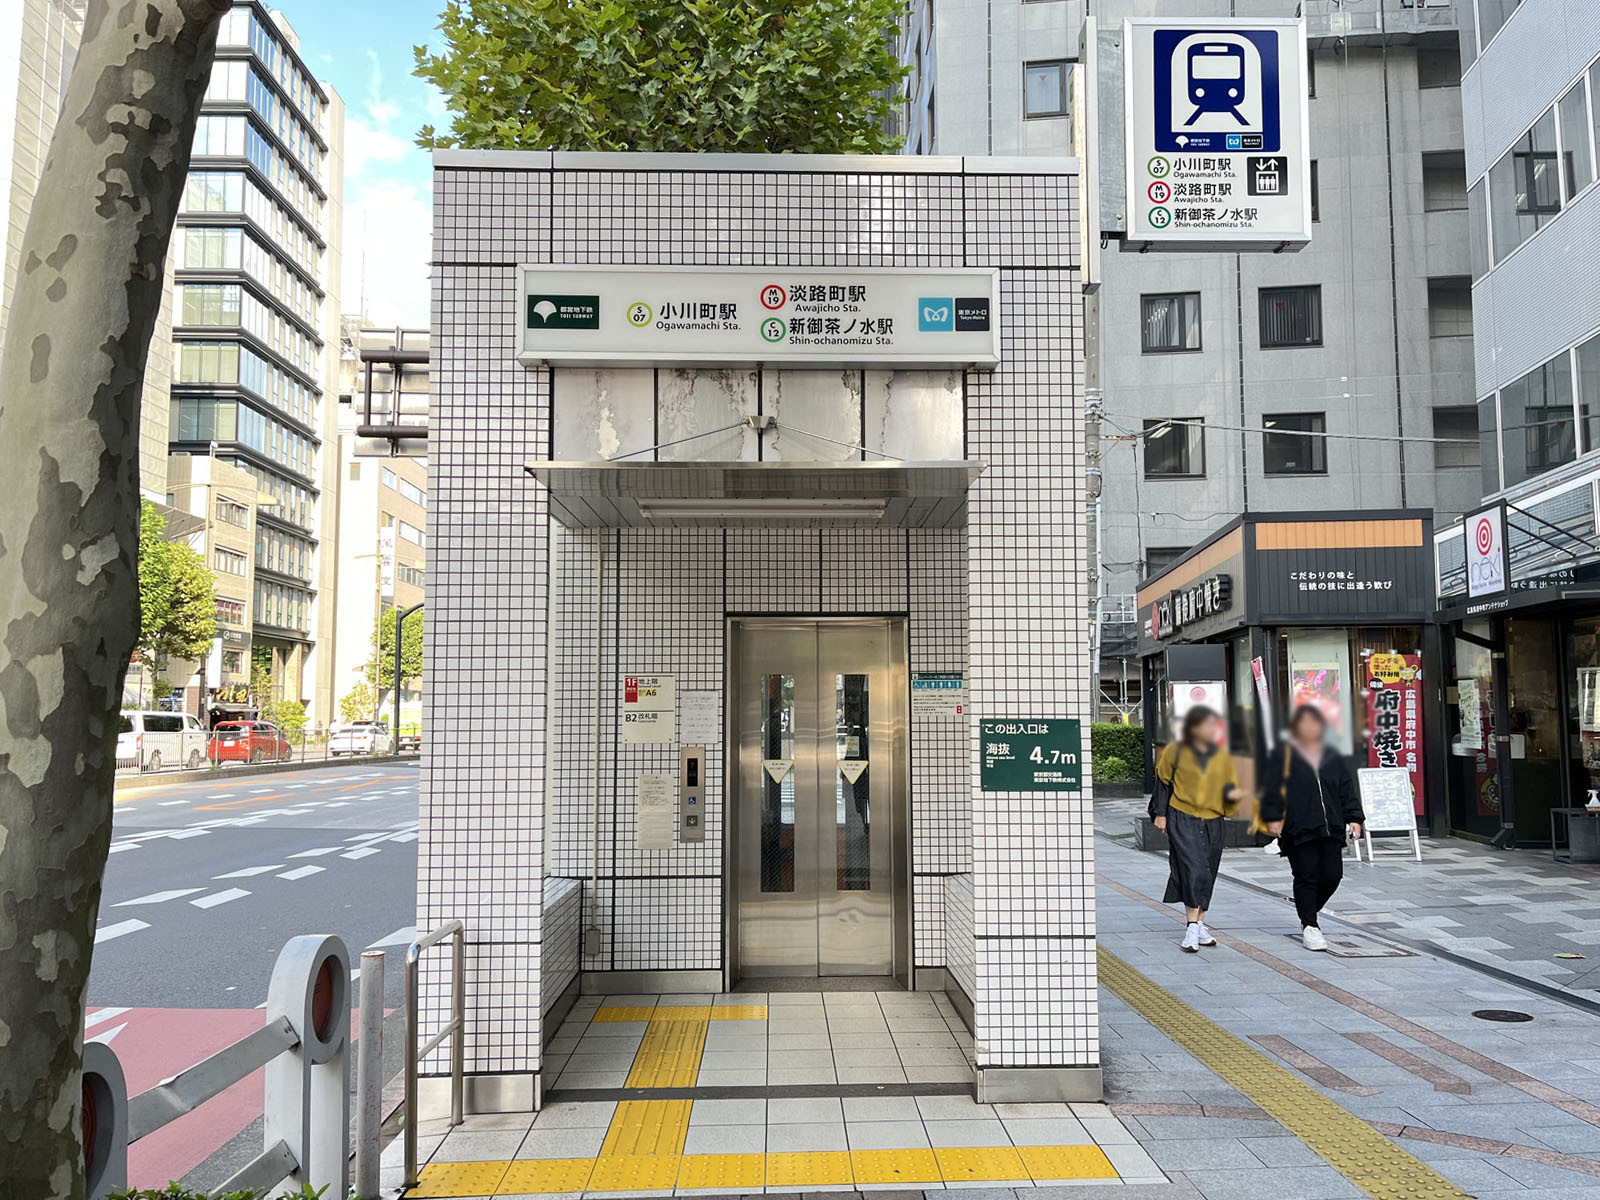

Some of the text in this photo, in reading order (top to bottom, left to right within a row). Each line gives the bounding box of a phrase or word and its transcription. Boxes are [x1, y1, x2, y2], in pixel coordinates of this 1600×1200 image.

[1173, 157, 1231, 171] 小川町駅
[1173, 183, 1232, 196] 淡路町駅
[1174, 208, 1258, 221] 新御茶ノ水駅
[789, 285, 866, 302] 淡路町駅
[767, 297, 780, 305] 19
[636, 306, 643, 314] S
[660, 302, 737, 320] 小川町駅
[795, 304, 861, 314] Awajicho Sta.
[633, 314, 646, 322] 07
[656, 321, 741, 331] Ogawamachi Sta.
[789, 318, 893, 335] 新御茶ノ水駅
[767, 329, 780, 337] 12
[789, 336, 894, 345] Shin-ochanomizu Sta.
[1290, 571, 1354, 580] こだわりの味と
[626, 678, 638, 687] 1F
[625, 714, 638, 722] B2
[1405, 689, 1417, 750] 広島県府中市
[984, 723, 1049, 735] この出入口は
[1373, 689, 1402, 768] 府中焼き
[986, 742, 1010, 755] 海抜
[1029, 746, 1077, 764] 4.7m
